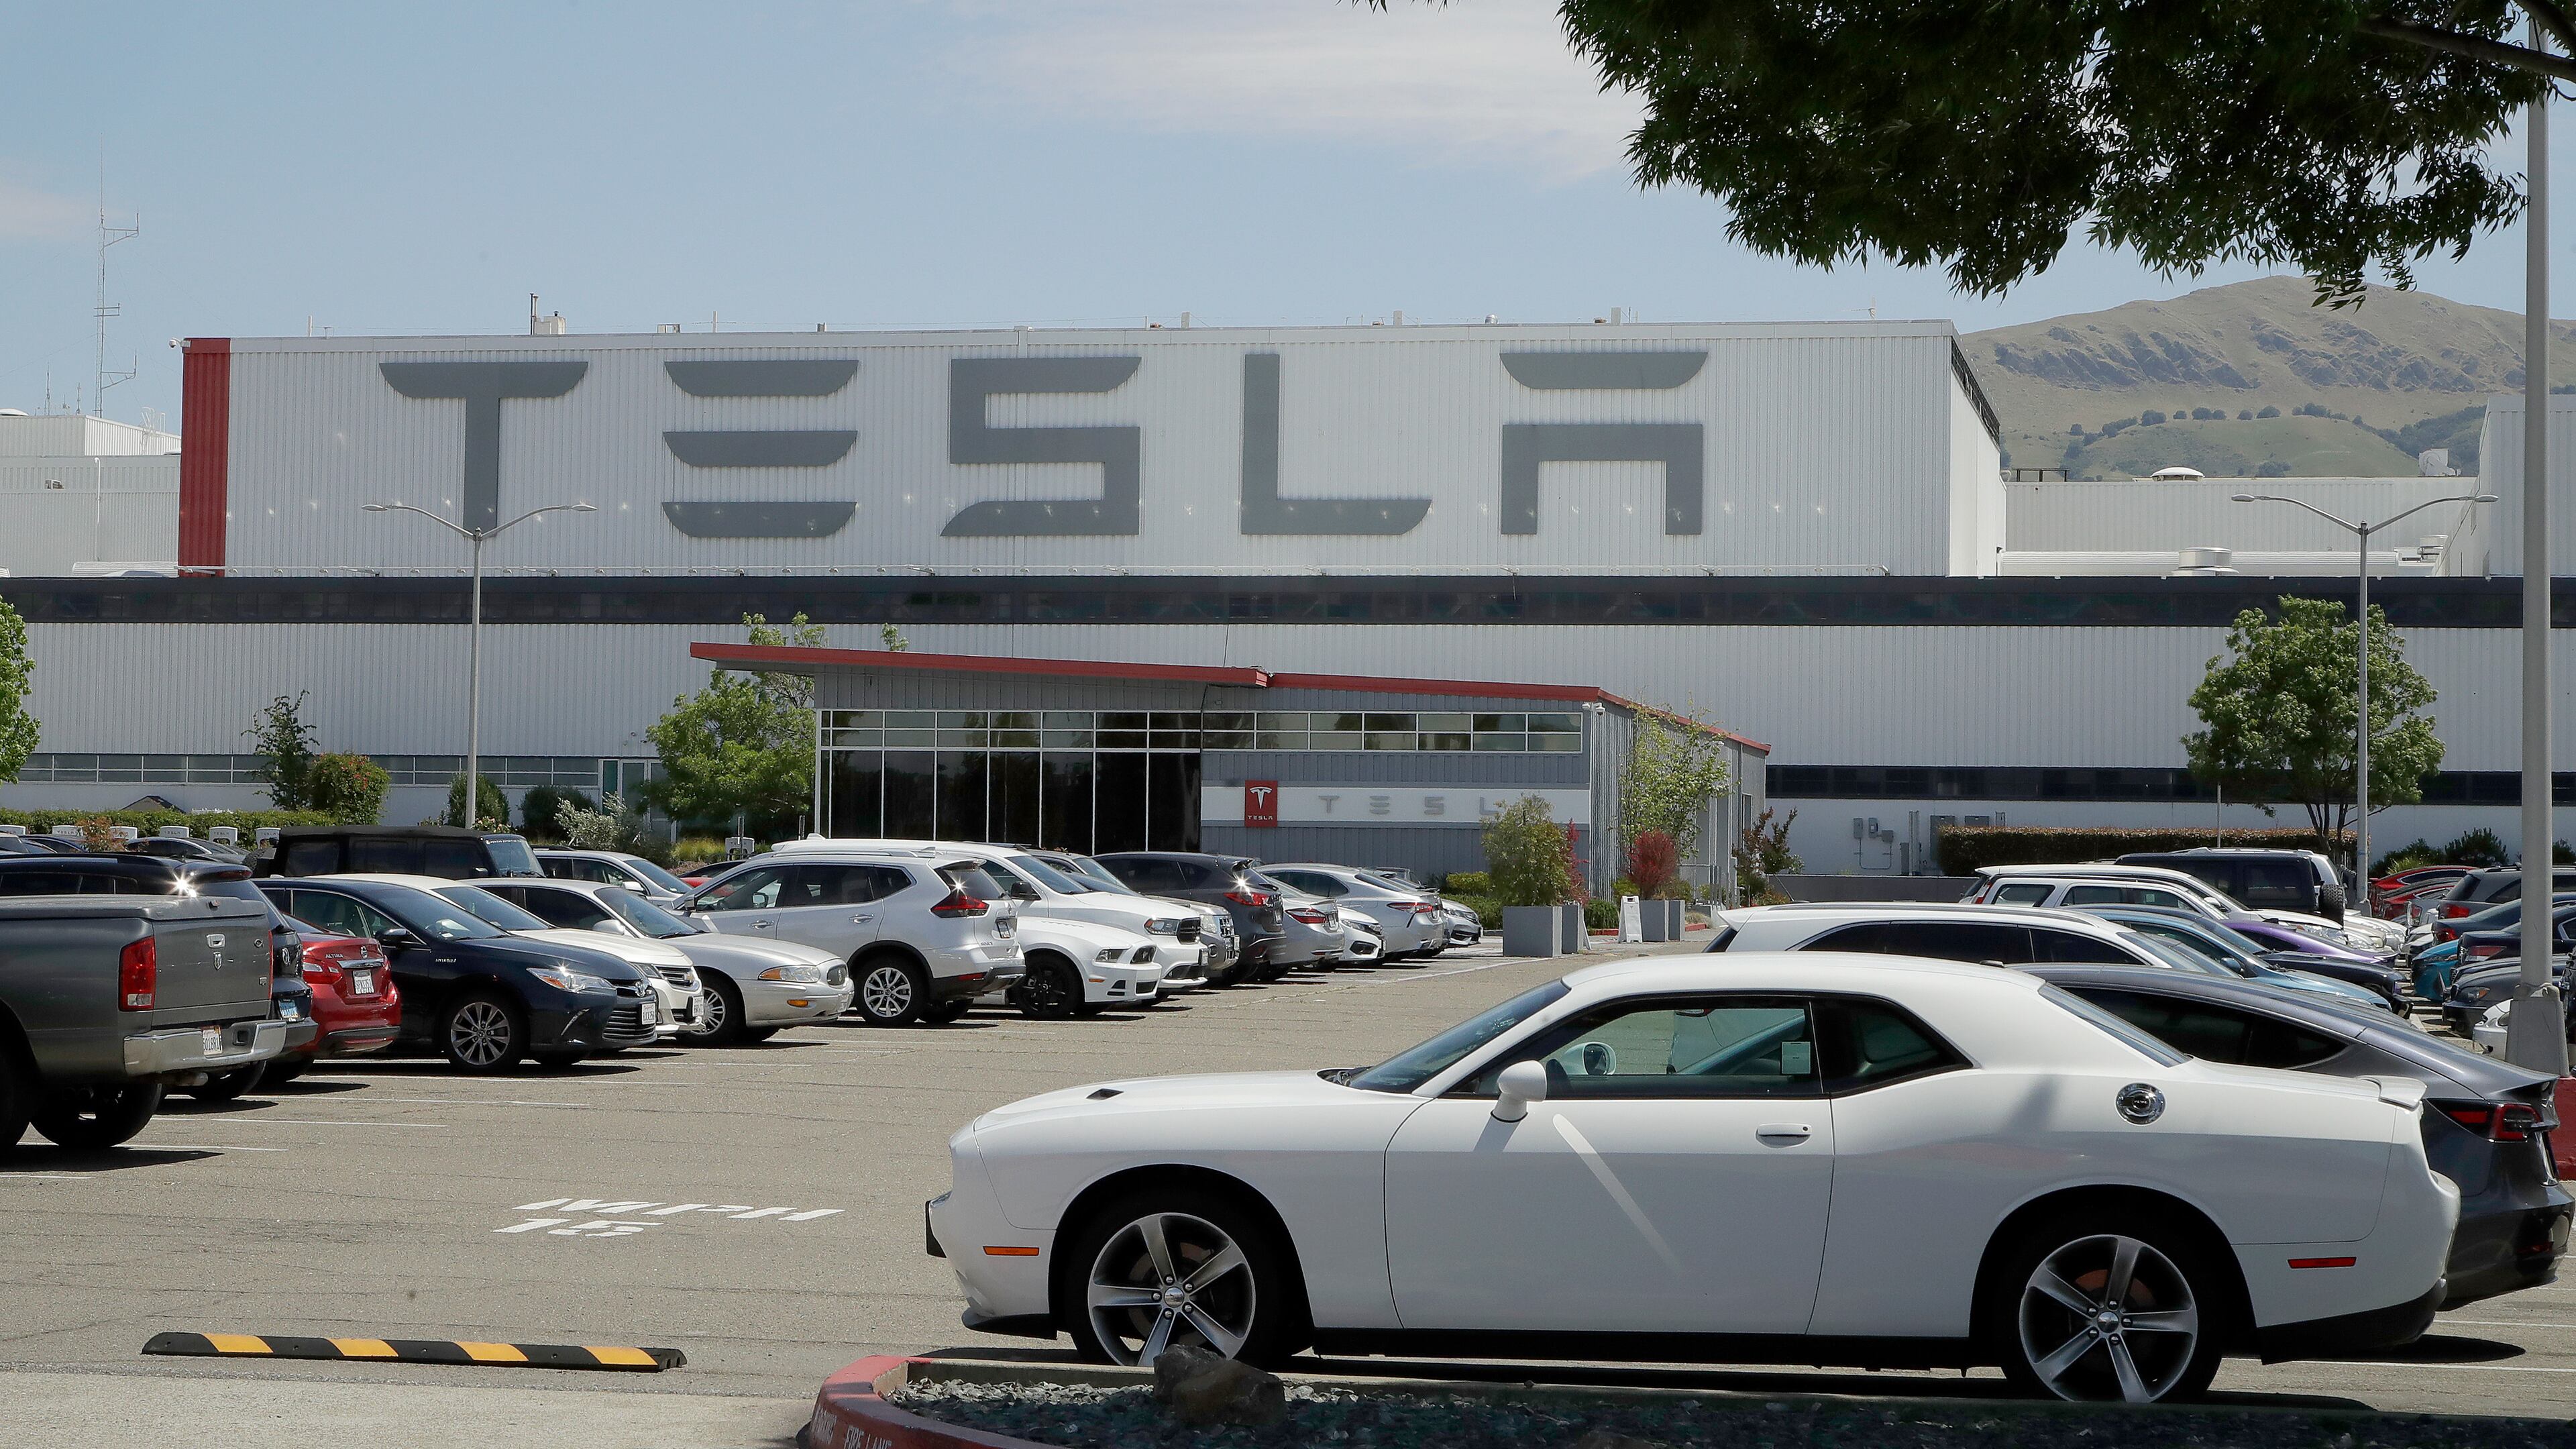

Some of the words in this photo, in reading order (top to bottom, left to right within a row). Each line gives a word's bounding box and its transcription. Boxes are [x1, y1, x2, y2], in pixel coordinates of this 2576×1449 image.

[378, 352, 1708, 538] TESLA
[1318, 796, 1503, 815] TESL
[512, 1198, 846, 1222] MPH
[491, 1218, 665, 1238] 15
